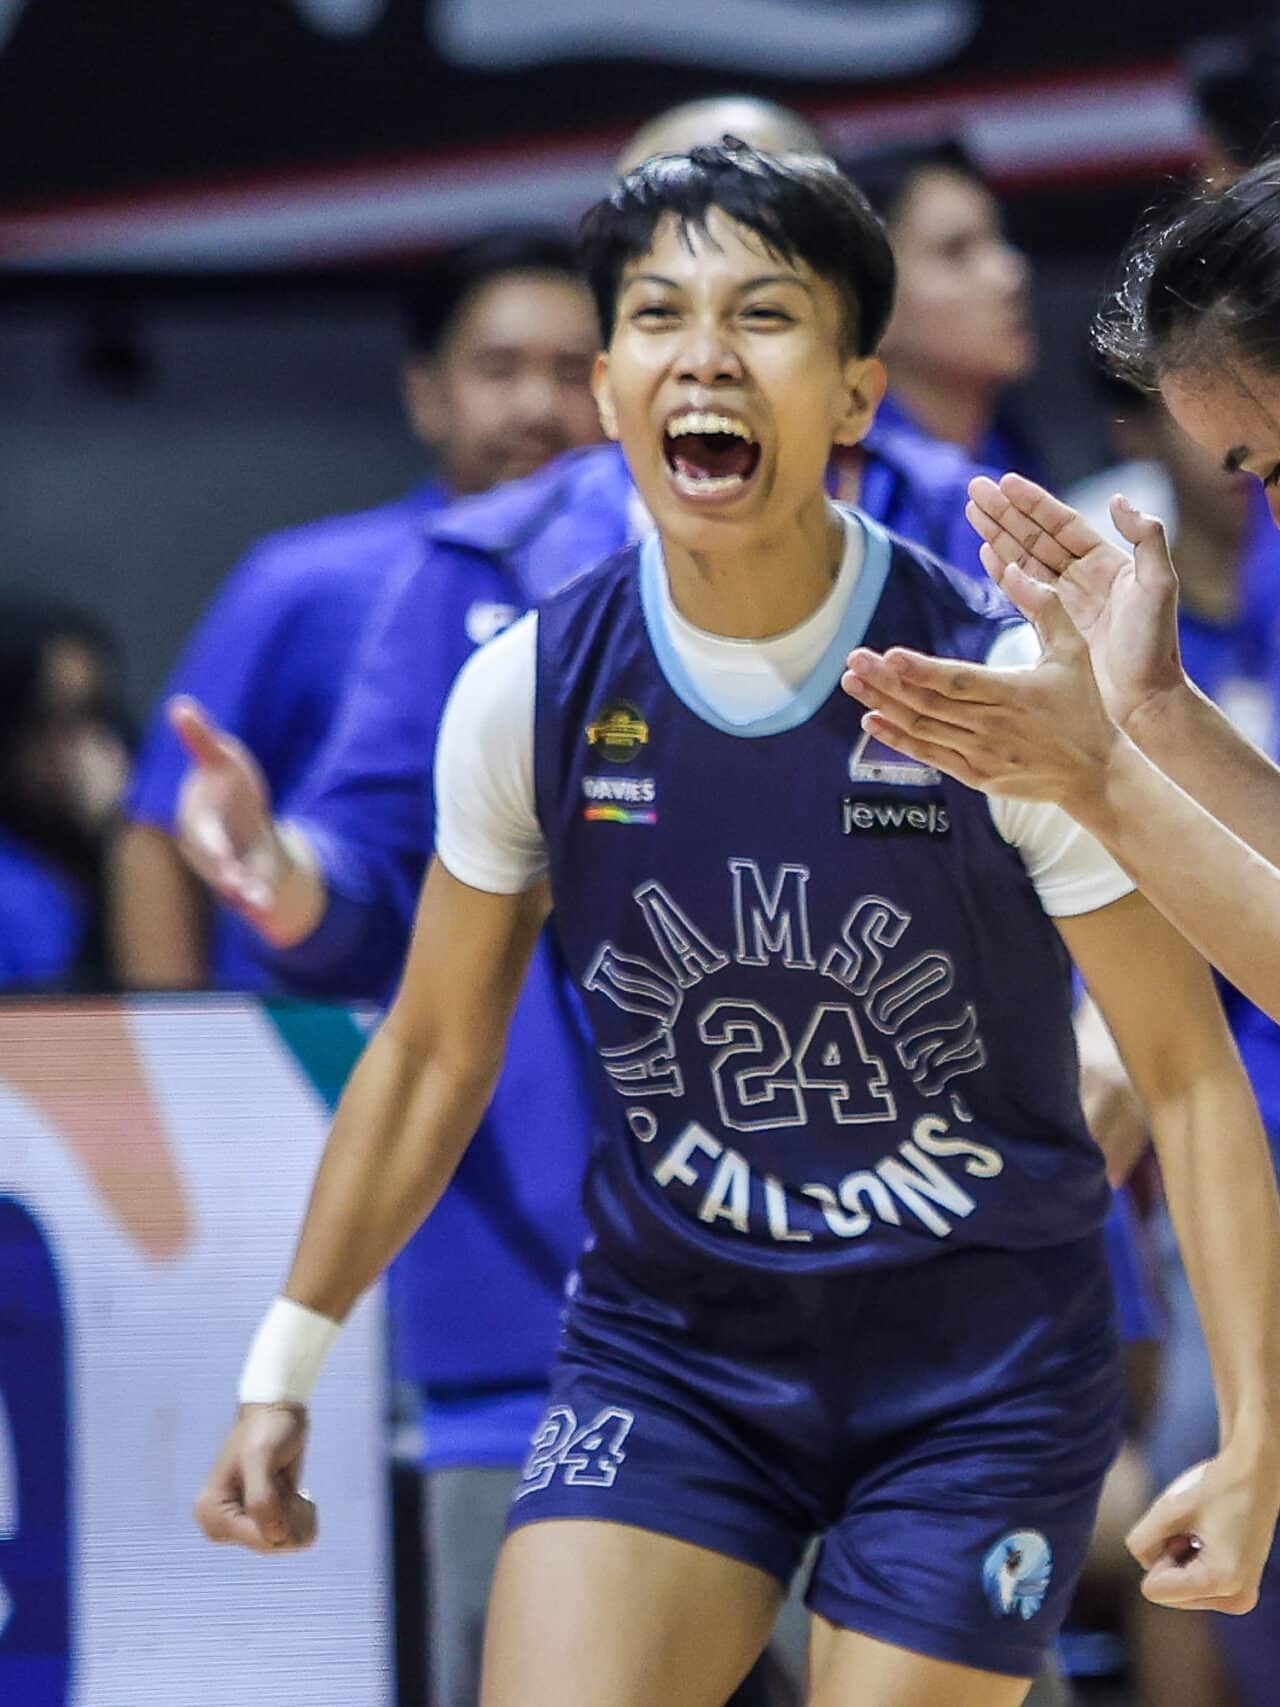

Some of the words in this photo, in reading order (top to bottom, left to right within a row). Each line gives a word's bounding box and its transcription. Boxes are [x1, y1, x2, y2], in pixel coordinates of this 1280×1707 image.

[843, 797, 950, 834] jewels
[583, 855, 987, 1097] ADAMSON
[698, 998, 898, 1132] 24
[513, 1404, 635, 1503] 24
